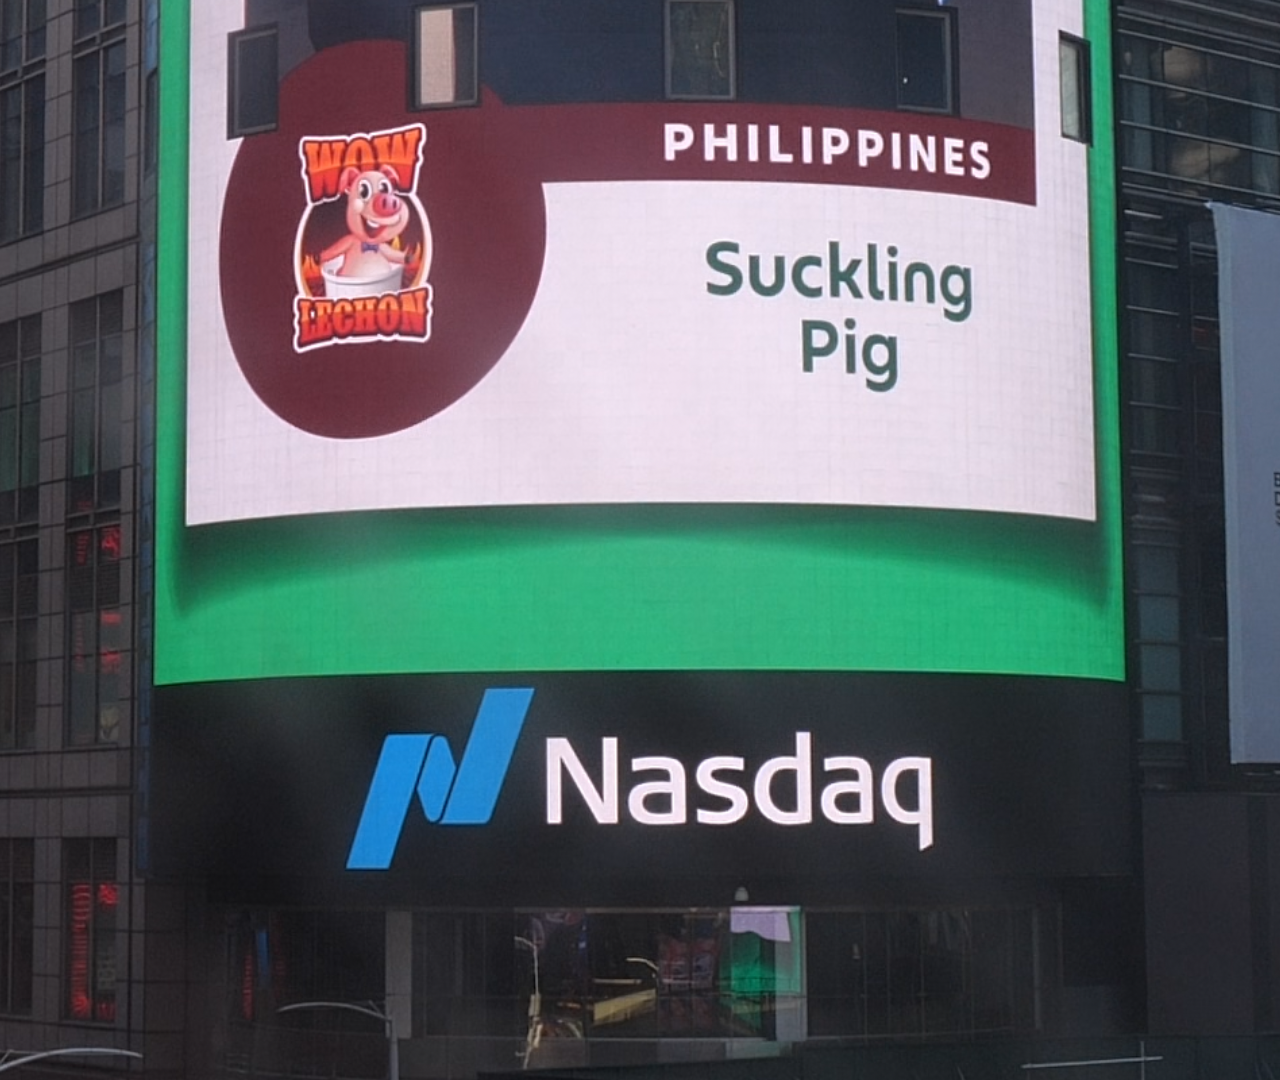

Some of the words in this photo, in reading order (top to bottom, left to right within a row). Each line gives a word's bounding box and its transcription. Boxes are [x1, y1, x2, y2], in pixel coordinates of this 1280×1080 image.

[304, 128, 421, 201] WOW
[664, 123, 991, 179] PHILIPPINES
[298, 288, 427, 346] LECHON
[705, 240, 972, 322] Suckling
[801, 317, 898, 392] Pig
[546, 731, 934, 851] Nasdaq
